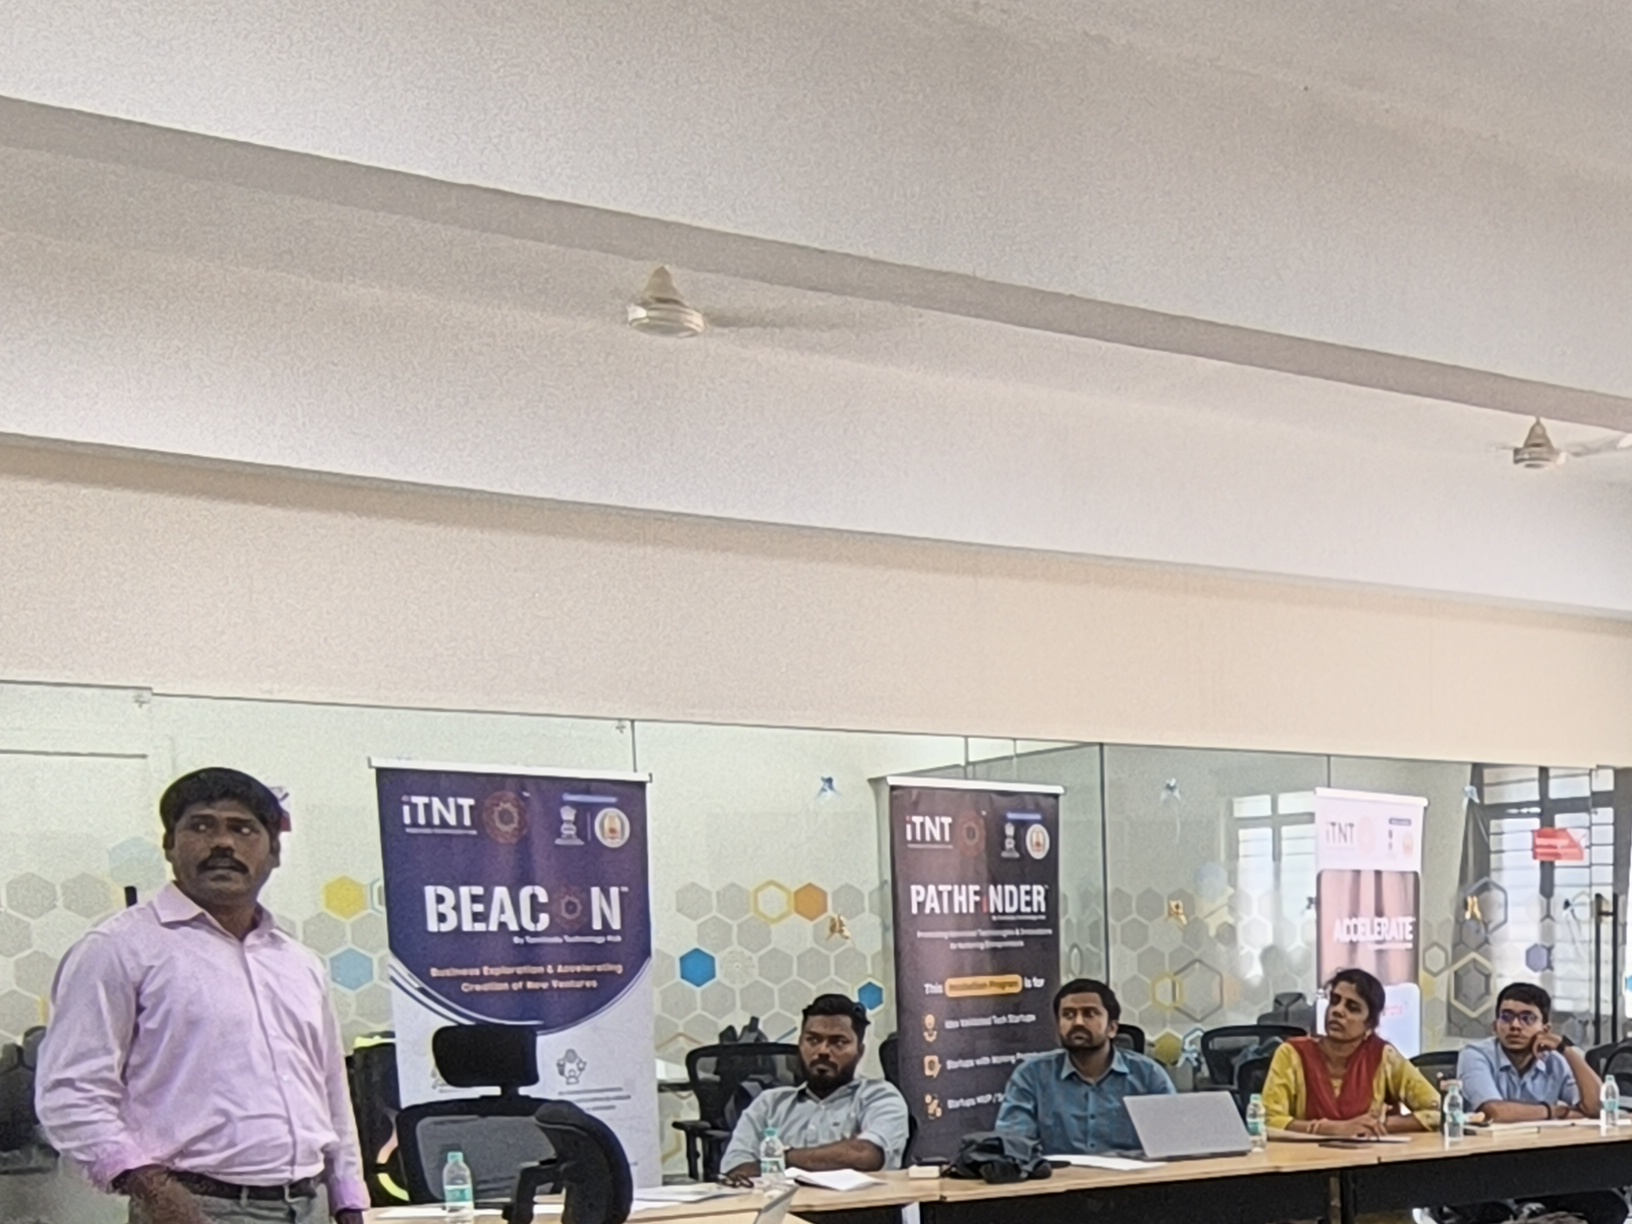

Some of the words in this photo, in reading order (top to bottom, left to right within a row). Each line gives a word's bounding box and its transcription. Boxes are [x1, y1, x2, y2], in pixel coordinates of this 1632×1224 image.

[401, 795, 475, 826] iTNT
[906, 815, 952, 842] iTNT
[1326, 821, 1355, 844] iTNT
[1333, 917, 1413, 942] ACCELERATE
